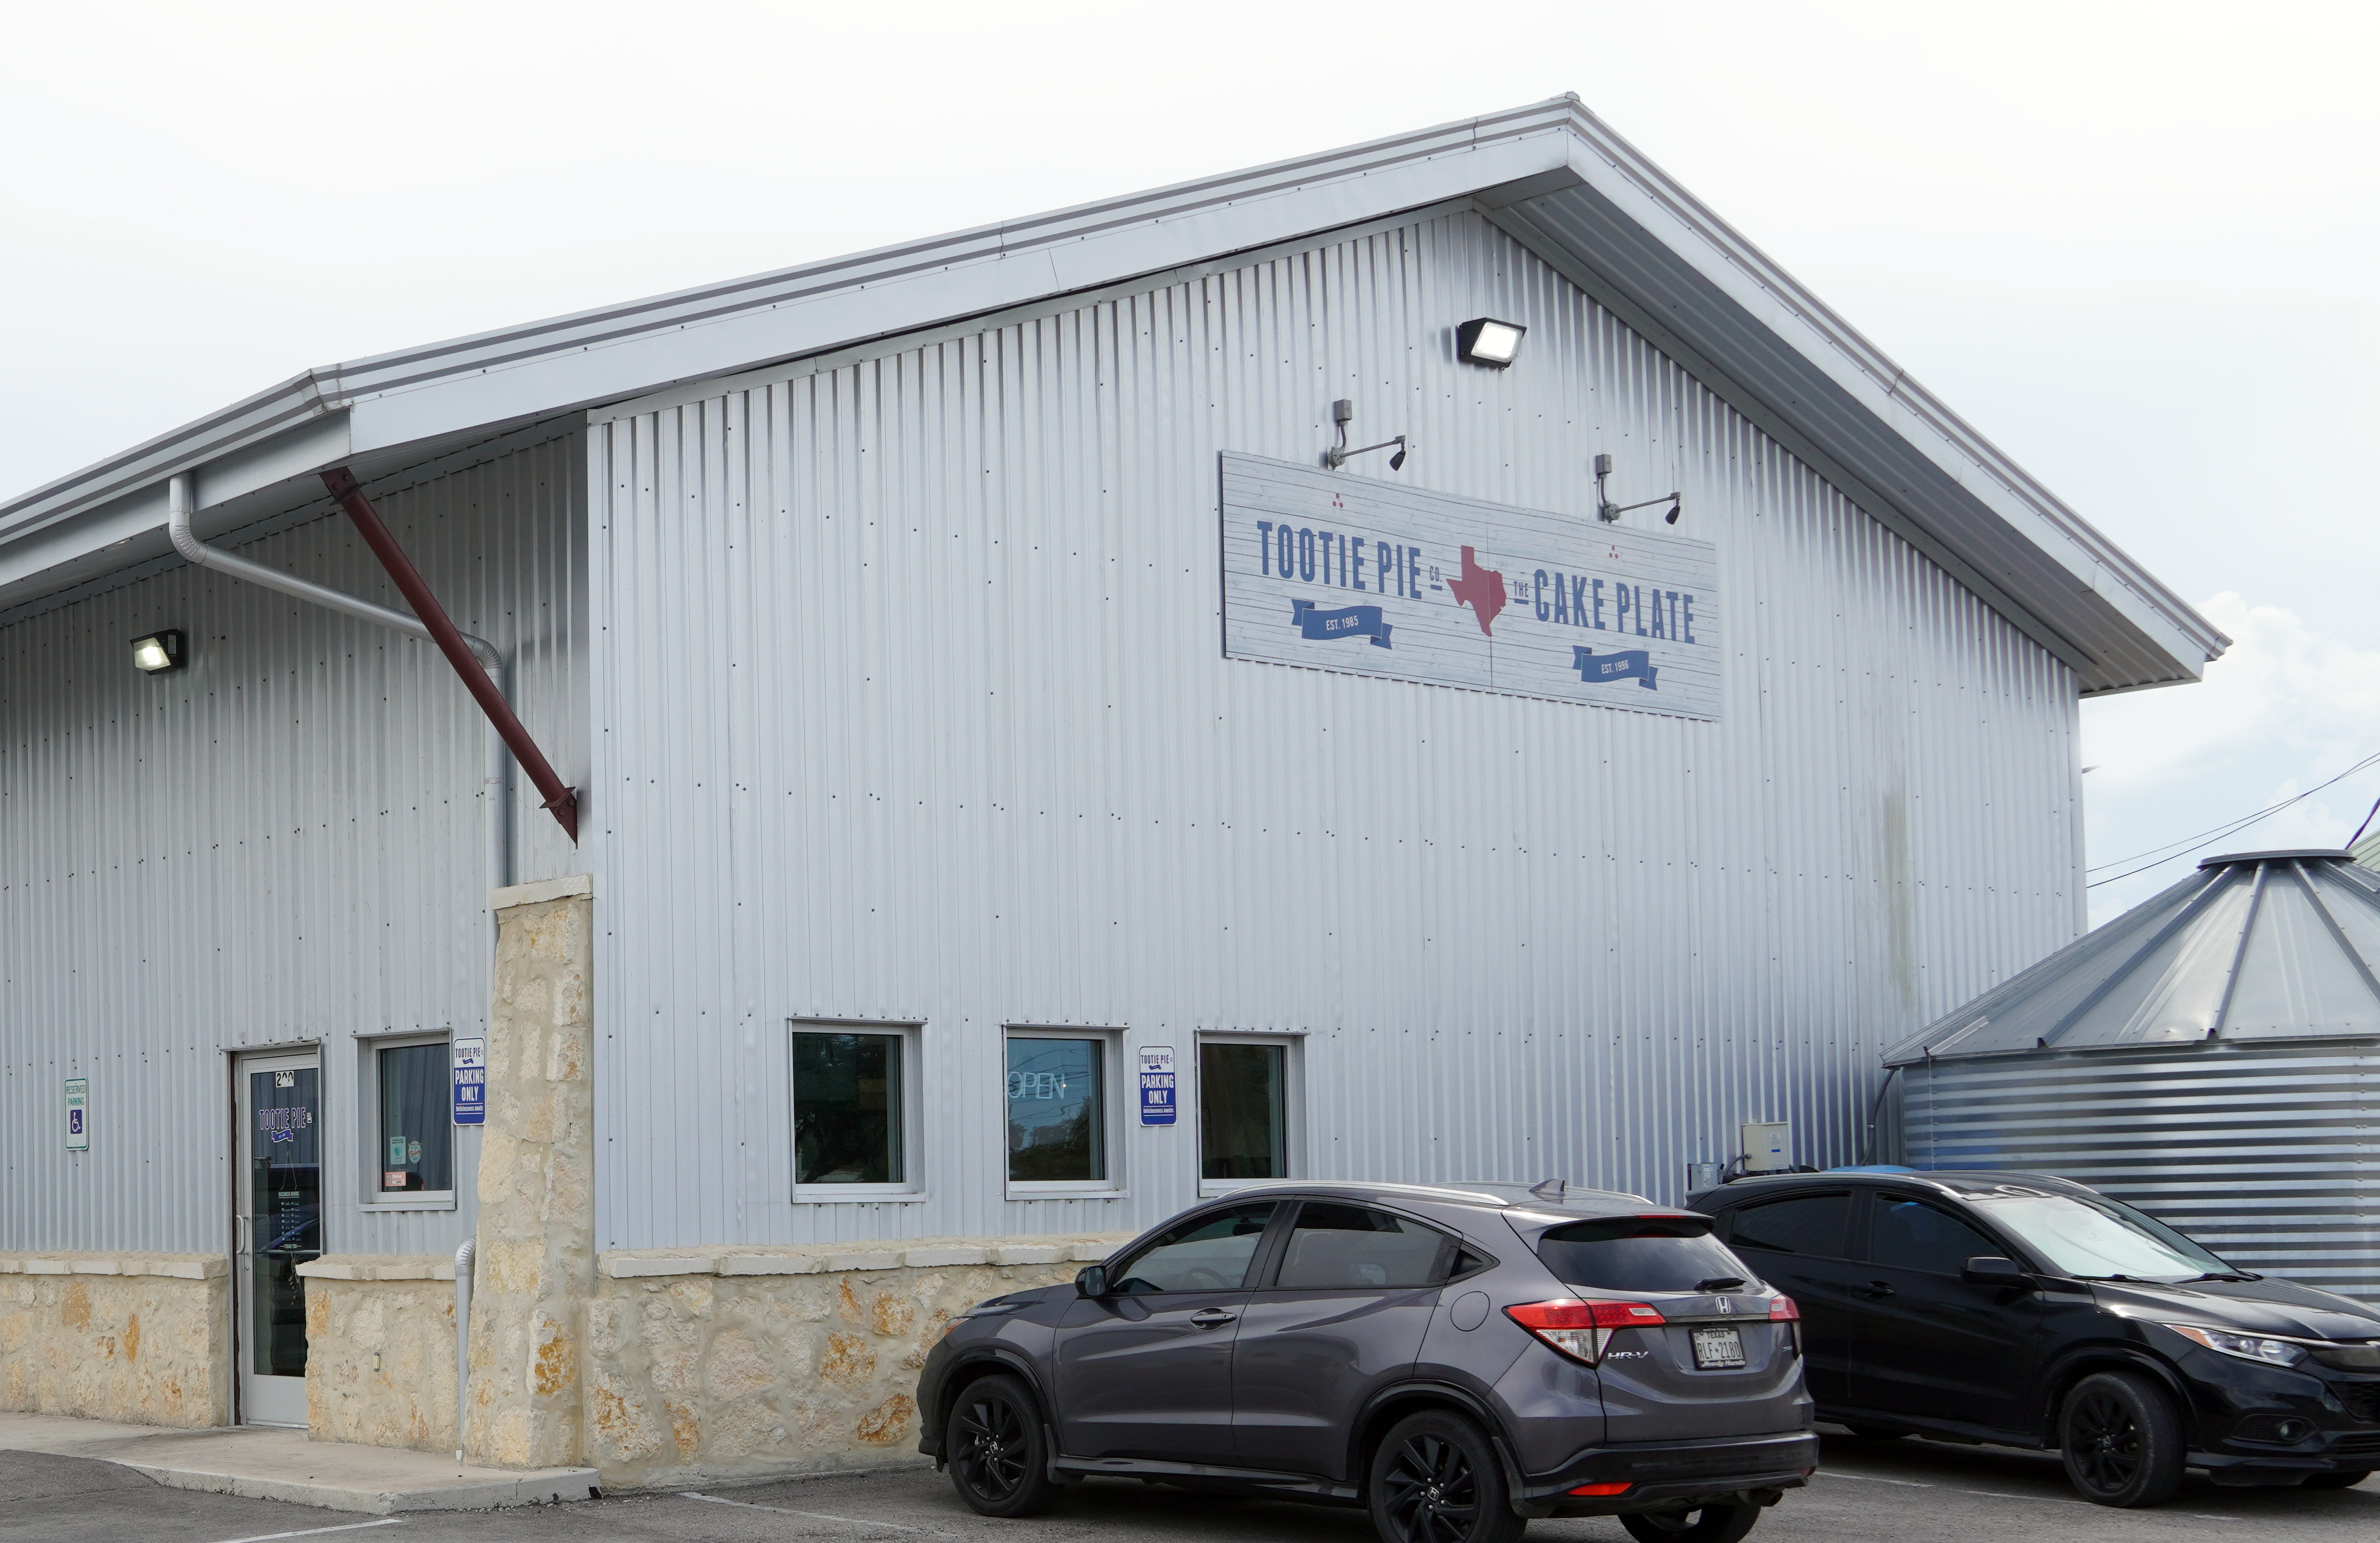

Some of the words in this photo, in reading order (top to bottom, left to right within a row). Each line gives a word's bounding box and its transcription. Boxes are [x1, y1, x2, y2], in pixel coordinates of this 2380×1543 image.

[1257, 521, 1366, 590] TOOTIE
[1377, 541, 1422, 599] PIE
[1513, 581, 1529, 598] THE
[1534, 569, 1606, 630] CAKE
[1616, 582, 1695, 644] PLATE
[1326, 619, 1341, 631] EST.
[1341, 615, 1359, 629] 1985
[1601, 663, 1614, 675] EST.
[1614, 659, 1629, 672] 1996
[455, 1047, 472, 1058] TOOTIE
[1141, 1055, 1159, 1064] TOOTIE
[1160, 1054, 1169, 1064] PIE
[455, 1068, 484, 1085] PARKING
[1141, 1074, 1174, 1089] PARKING
[66, 1085, 85, 1094] RESERVED
[1008, 1071, 1065, 1100] OPEN
[461, 1086, 479, 1101] ONLY
[1148, 1090, 1168, 1104] ONLY
[68, 1097, 84, 1106] PARKING
[259, 1108, 290, 1130] TOOTIE
[291, 1107, 306, 1129] PIE
[1607, 1351, 1649, 1360] HR-V
